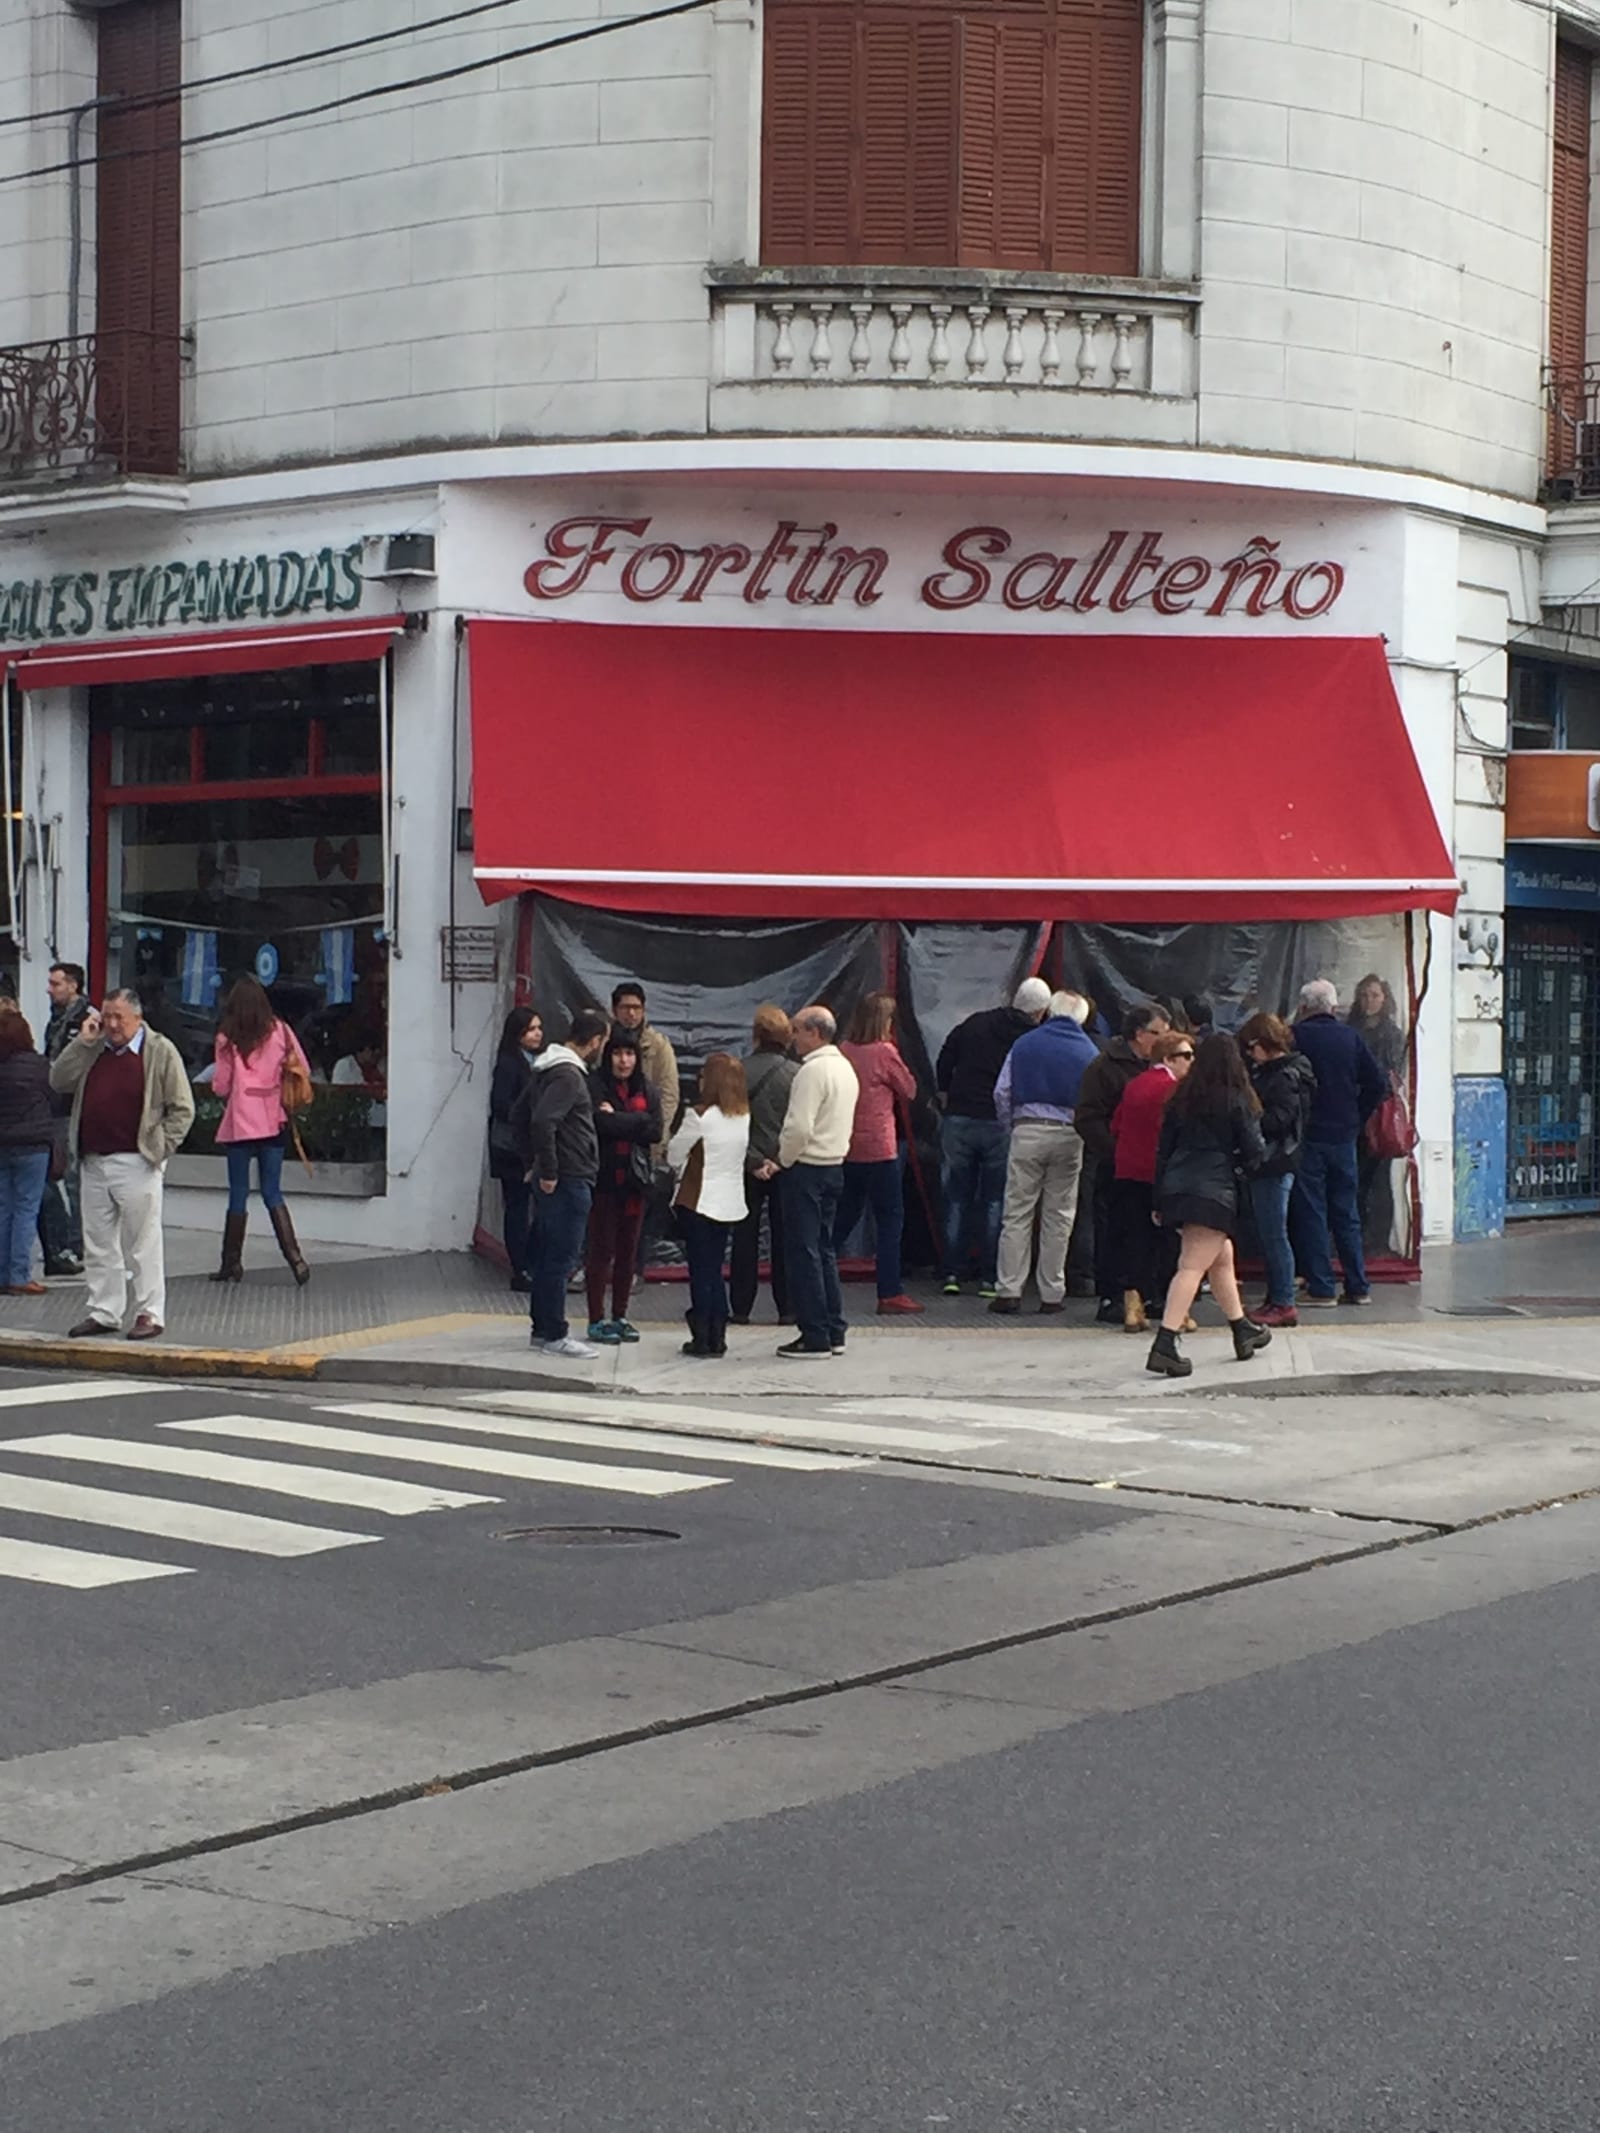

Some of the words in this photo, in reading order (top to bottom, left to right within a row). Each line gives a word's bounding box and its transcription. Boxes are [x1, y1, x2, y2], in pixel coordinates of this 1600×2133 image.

[0, 573, 98, 643] ALES
[105, 543, 363, 631] EMPANADAS
[921, 526, 1346, 620] Salteño
